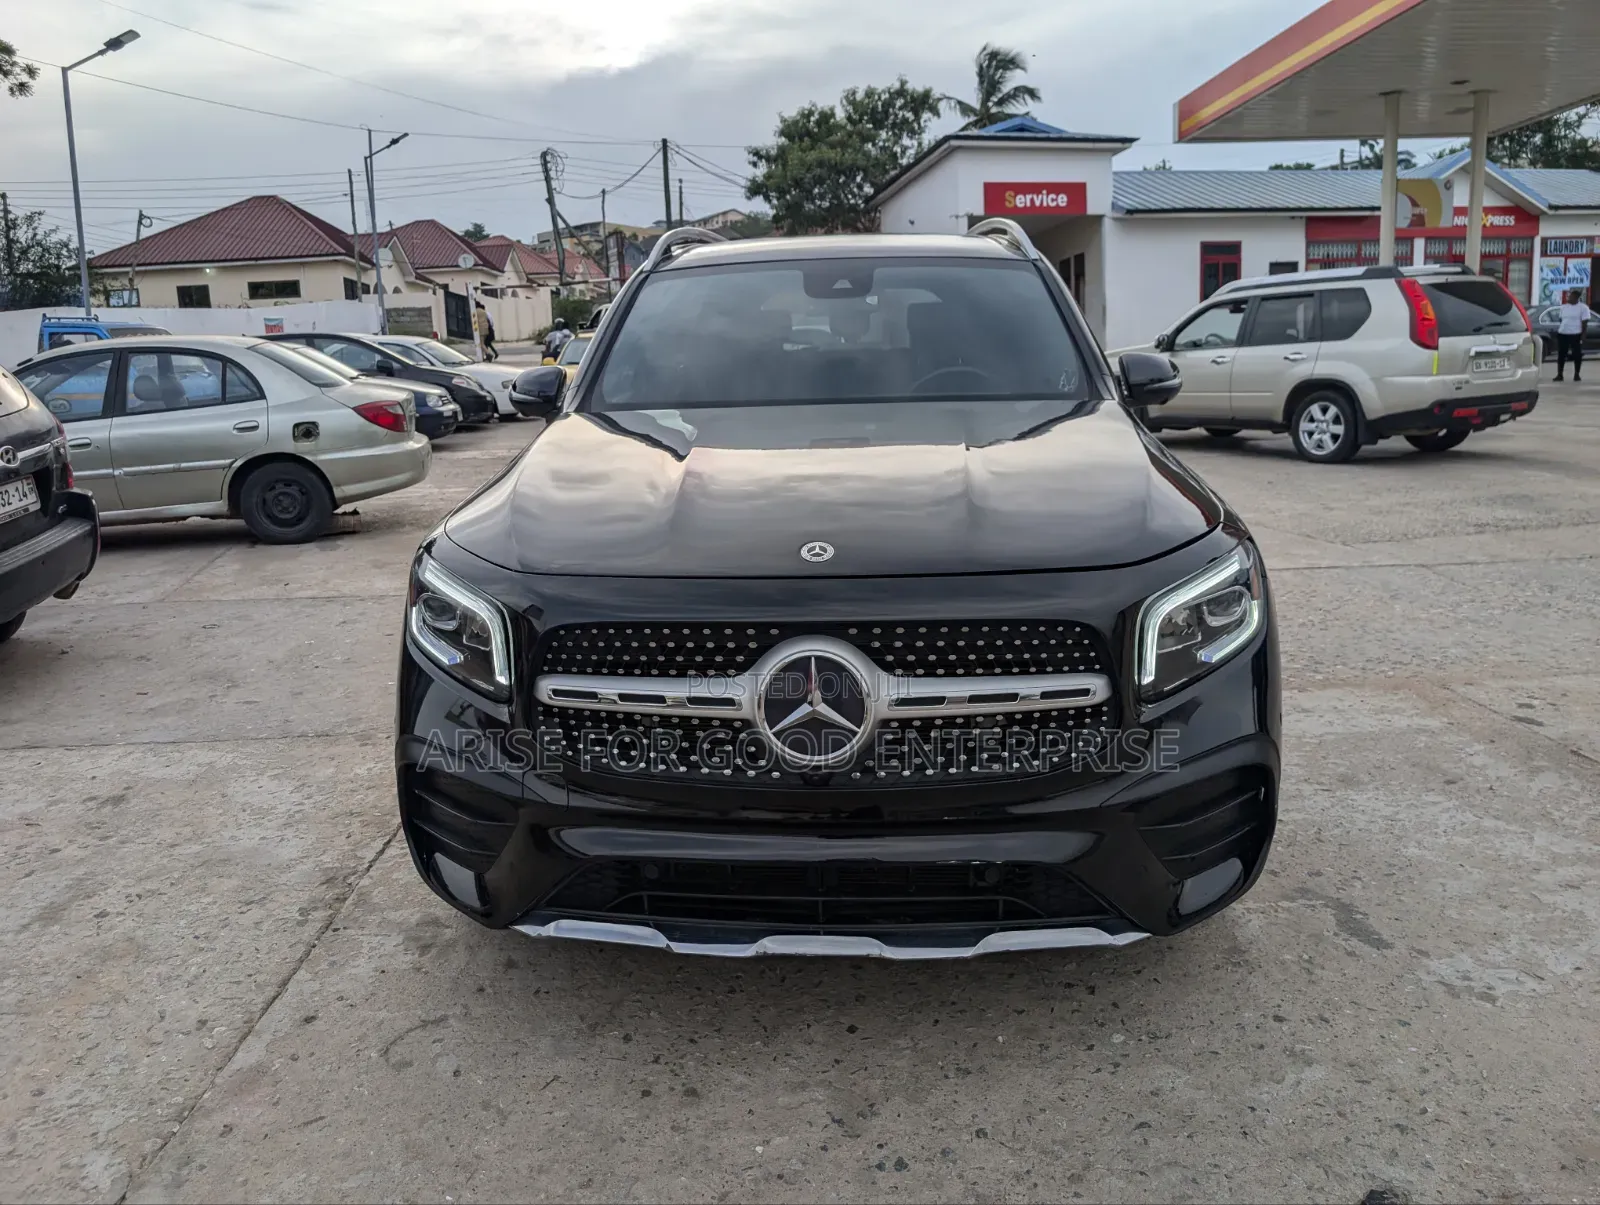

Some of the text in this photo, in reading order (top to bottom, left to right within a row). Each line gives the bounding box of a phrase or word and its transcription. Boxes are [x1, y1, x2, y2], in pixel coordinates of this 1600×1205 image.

[1005, 189, 1067, 208] Service
[1549, 240, 1584, 253] LAUNDRY
[1567, 276, 1584, 284] OPEN
